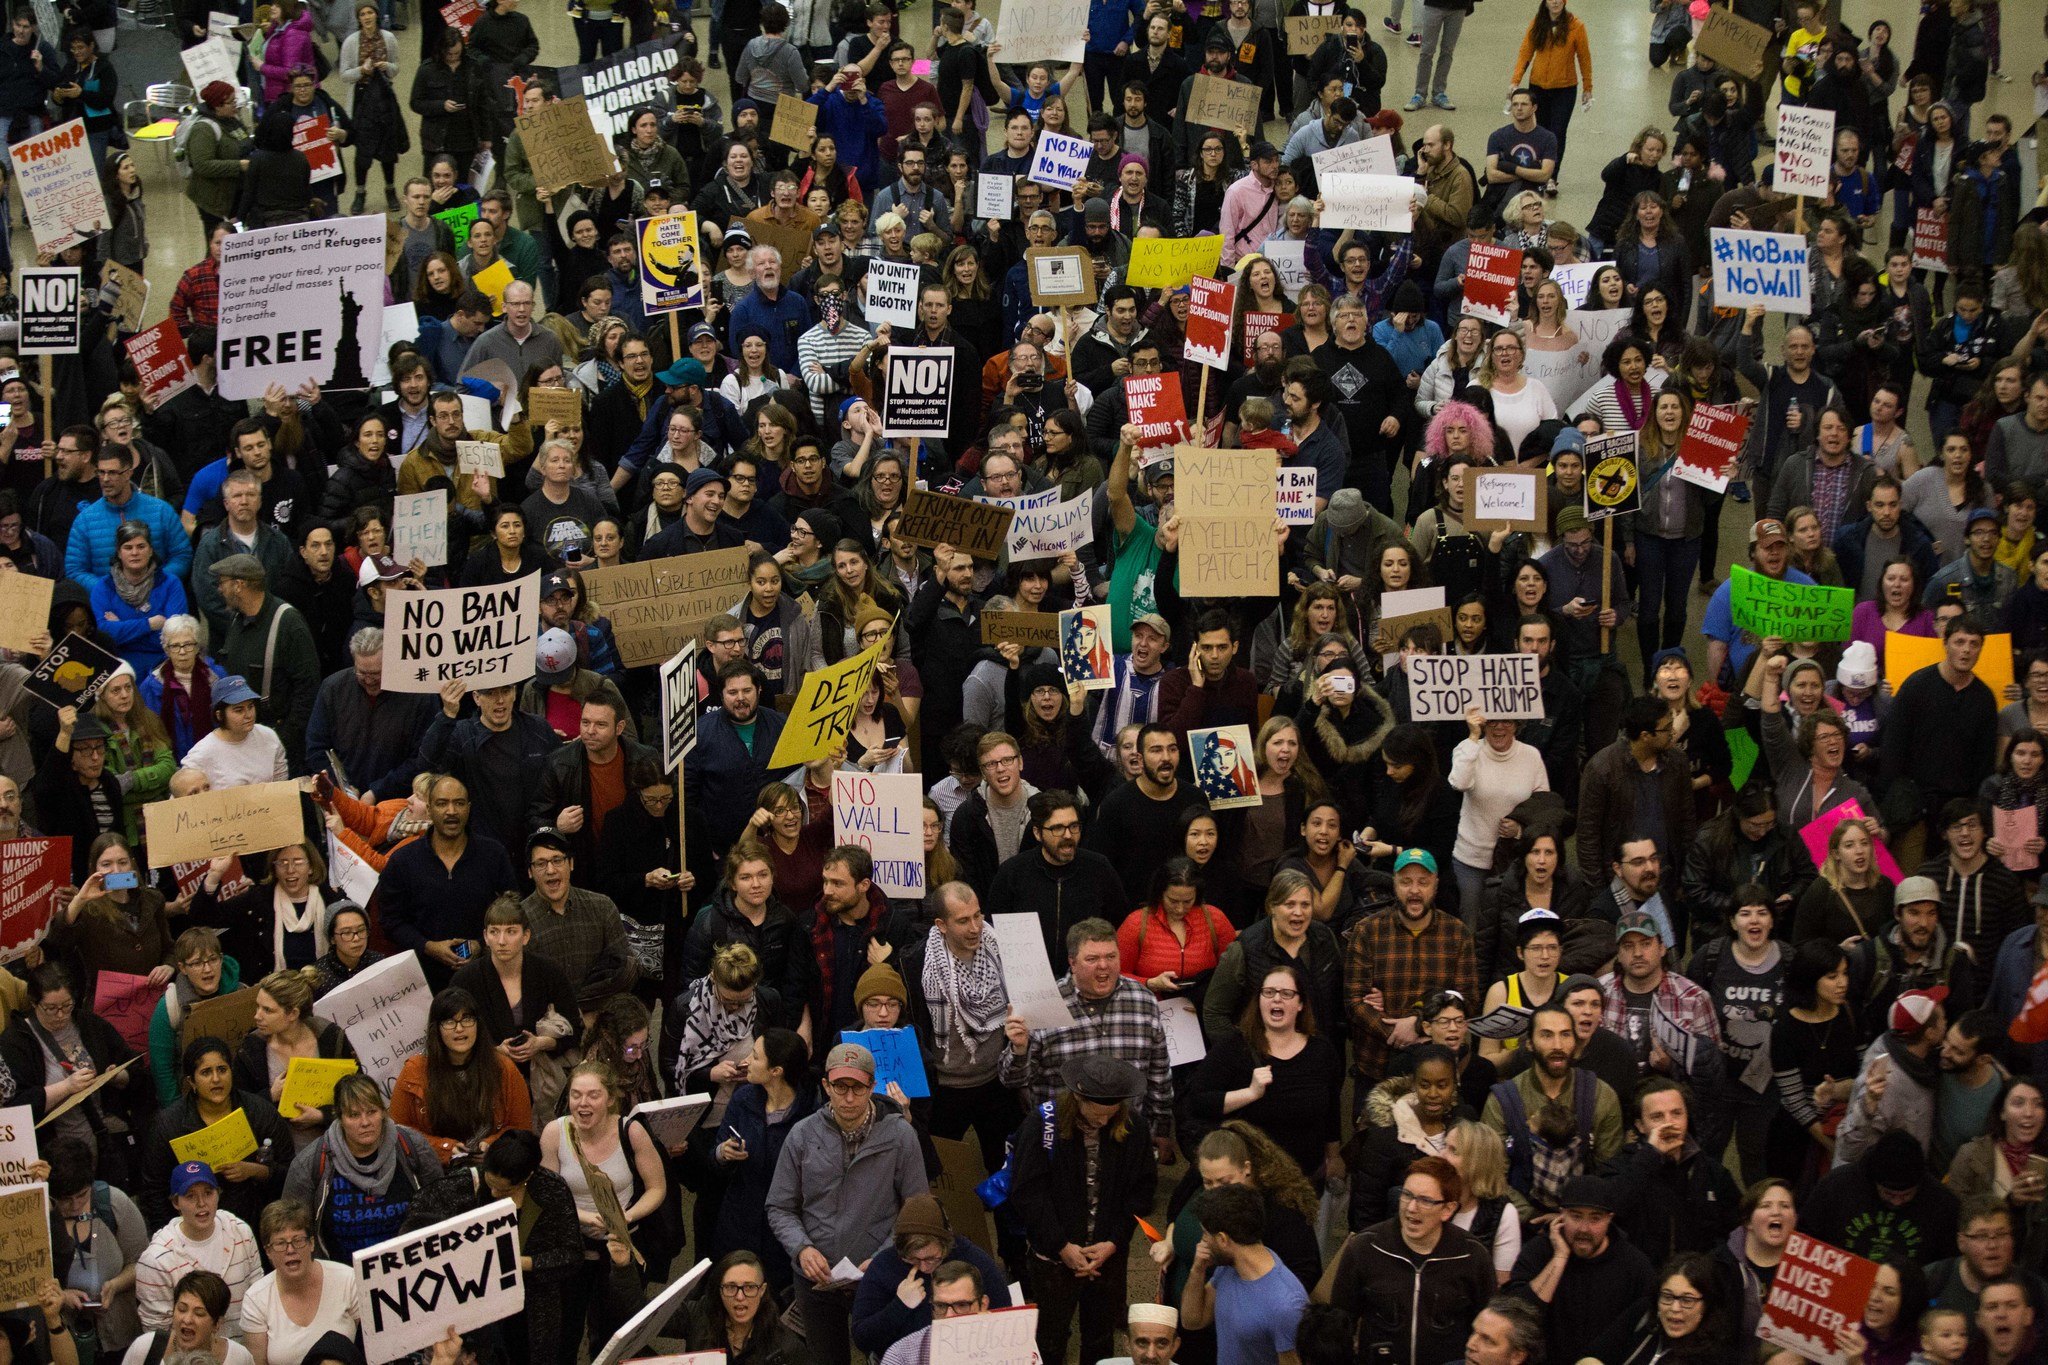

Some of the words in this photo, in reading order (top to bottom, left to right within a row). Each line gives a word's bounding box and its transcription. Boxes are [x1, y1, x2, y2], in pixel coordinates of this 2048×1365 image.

[1010, 6, 1035, 33] NO
[1047, 5, 1088, 28] BAN
[1299, 18, 1321, 31] NO
[1300, 34, 1319, 45] NO
[582, 49, 679, 96] RAILROAD
[519, 107, 561, 131] DEATH
[567, 101, 583, 115] TO
[12, 124, 85, 163] TRUMP
[1045, 138, 1067, 152] NO
[1069, 142, 1093, 159] BAN
[1330, 147, 1354, 163] Stand
[1039, 157, 1053, 173] NO
[1790, 152, 1812, 168] NO
[1780, 168, 1826, 187] TRUMP
[652, 217, 671, 225] STOP
[1916, 222, 1941, 237] LIVES
[225, 236, 254, 251] Stand
[257, 237, 270, 246] up
[274, 232, 289, 242] for
[292, 227, 338, 240] Liberty,
[651, 236, 692, 247] TOGETHER
[661, 231, 680, 239] COME
[224, 245, 297, 263] Immigrants,
[301, 241, 321, 251] and
[325, 235, 382, 249] Refugees
[1144, 243, 1163, 256] NO
[1171, 240, 1215, 257] BAN!!!
[1471, 243, 1510, 259] SOLIDARITY
[870, 263, 885, 276] NO
[886, 264, 919, 281] UNITY
[1140, 265, 1162, 277] NO
[1170, 258, 1216, 276] WALL!!!
[1469, 254, 1490, 270] NOT
[223, 278, 246, 288] Give
[250, 275, 266, 283] me
[269, 271, 293, 283] your
[296, 265, 324, 278] tired,
[328, 265, 352, 276] your
[355, 262, 383, 274] poor,
[1192, 276, 1226, 294] SOLIDARITY
[1467, 269, 1516, 287] SCAPEGOATING
[25, 278, 76, 313] NO!
[223, 291, 246, 301] Your
[249, 281, 293, 295] huddled
[296, 279, 333, 289] masses
[878, 279, 905, 295] WITH
[1191, 289, 1210, 305] NOT
[222, 299, 268, 314] yearning
[869, 294, 914, 312] BIGOTRY
[1189, 304, 1230, 325] SCAPEGOATING
[221, 314, 232, 325] to
[236, 310, 276, 323] breathe
[1246, 314, 1279, 326] UNIONS
[127, 327, 162, 353] UNIONS
[1580, 318, 1609, 341] NO
[131, 343, 161, 366] MAKE
[221, 328, 322, 371] FREE
[137, 360, 151, 375] US
[142, 360, 178, 388] STRONG
[892, 359, 949, 395] NO!
[1126, 377, 1162, 394] UNIONS
[1128, 393, 1157, 409] MAKE
[889, 417, 944, 426] RefuseFascism.org
[1130, 410, 1144, 424] US
[1691, 413, 1714, 431] NOT
[1695, 403, 1736, 423] SOLIDARITY
[1687, 428, 1738, 452] SCAPEGOATING
[457, 445, 499, 468] RESIST
[1177, 455, 1269, 483] WHAT'S
[1191, 483, 1271, 510] NEXT?
[1479, 476, 1517, 495] Refugees
[399, 497, 437, 518] LET
[911, 492, 966, 524] TRUMP
[970, 506, 1008, 530] OUT
[1481, 492, 1525, 509] Welcome!
[1014, 497, 1090, 534] MUSLIMS
[394, 519, 446, 545] THEM
[898, 513, 968, 547] REFUGEES
[971, 526, 998, 551] IN
[1198, 519, 1275, 549] YELLOW
[1012, 536, 1029, 554] ARE
[1030, 540, 1067, 552] WELCOME
[700, 563, 748, 586] TACOMA
[1197, 550, 1274, 583] PATCH?
[1748, 574, 1837, 604] RESIST
[402, 598, 444, 631] NO
[462, 585, 522, 625] BAN
[628, 604, 675, 626] STAND
[678, 600, 711, 618] WITH
[982, 612, 1003, 620] THE
[400, 632, 443, 661] NO
[451, 614, 531, 655] WALL
[988, 624, 1059, 642] RESISTANCE
[35, 645, 70, 681] STOP
[438, 652, 514, 682] RESIST
[1413, 658, 1469, 686] STOP
[1481, 657, 1535, 686] HATE
[76, 670, 110, 704] BIGOTRY
[669, 655, 694, 720] NO!
[1416, 689, 1473, 715] STOP
[1478, 686, 1539, 713] TRUMP
[836, 777, 875, 806] NO
[175, 812, 223, 833] Muslims
[224, 805, 271, 824] Welcome
[838, 804, 910, 836] WALL
[2, 840, 49, 858] UNIONS
[209, 832, 246, 848] Here
[2, 856, 43, 890] SOLIDARITY
[2, 881, 26, 907] NOT
[2, 880, 54, 920] SCAPEGOATING
[1725, 986, 1772, 1002] CUTE
[332, 1001, 365, 1031] Let
[372, 982, 418, 1010] them
[369, 1010, 404, 1041] in!!!
[1160, 1006, 1180, 1055] RESIST
[866, 1032, 900, 1053] LET
[372, 1056, 389, 1069] to
[1042, 1121, 1055, 1150] NEW
[361, 1213, 518, 1281] FREEDOM
[1784, 1233, 1853, 1277] BLACK
[370, 1232, 517, 1333] NOW!
[1776, 1261, 1834, 1299] LIVES
[1768, 1286, 1846, 1332] MATTER
